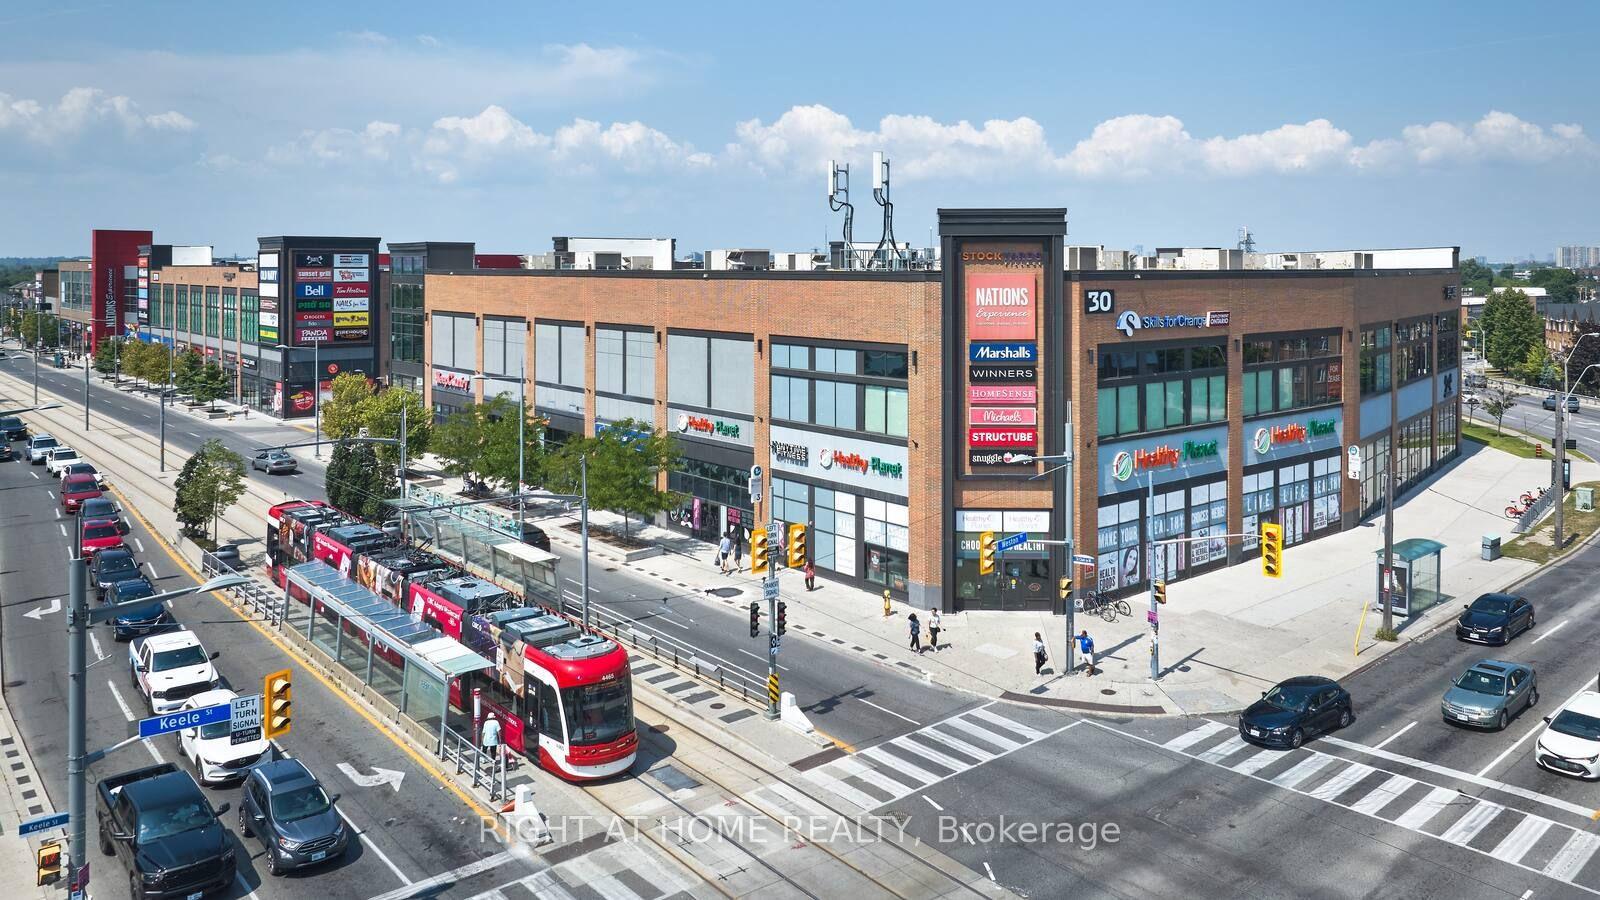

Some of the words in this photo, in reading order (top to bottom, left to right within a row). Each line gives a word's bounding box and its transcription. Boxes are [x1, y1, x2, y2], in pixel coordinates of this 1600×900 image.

[305, 285, 324, 296] Bell
[976, 288, 1028, 306] NATIONS
[1088, 291, 1111, 312] 30
[106, 300, 116, 327] NATIONS
[976, 308, 1029, 320] Experience
[1144, 316, 1164, 328] Skills
[1164, 315, 1177, 328] for
[976, 346, 1030, 358] Marshalls
[984, 409, 1022, 422] Michaels
[688, 416, 714, 433] Healthy
[716, 420, 740, 438] Planet
[1270, 423, 1306, 445] Healthy
[1307, 417, 1336, 437] Planet
[972, 432, 1032, 442] STRUCTUBE
[972, 454, 1002, 464] snuggle
[1134, 445, 1180, 470] Healthy
[1183, 439, 1217, 461] Planet
[833, 450, 868, 473] Healthy
[871, 456, 902, 476] Planet
[768, 532, 777, 540] URN
[1098, 530, 1118, 548] MAKE
[1154, 514, 1184, 535] EALTHY
[1002, 538, 1019, 549] Weston
[1100, 566, 1116, 579] HEALTH
[764, 580, 778, 590] TRANSIT
[1099, 576, 1116, 592] FOODS
[765, 588, 778, 597] SIGNAL
[235, 699, 256, 709] LEFT
[160, 712, 200, 730] Keele
[206, 708, 213, 716] St
[234, 708, 258, 720] TURN
[232, 720, 259, 730] SIGNAL
[232, 733, 261, 744] PERMITTED
[236, 728, 257, 738] U-TURN
[28, 820, 51, 832] Keele
